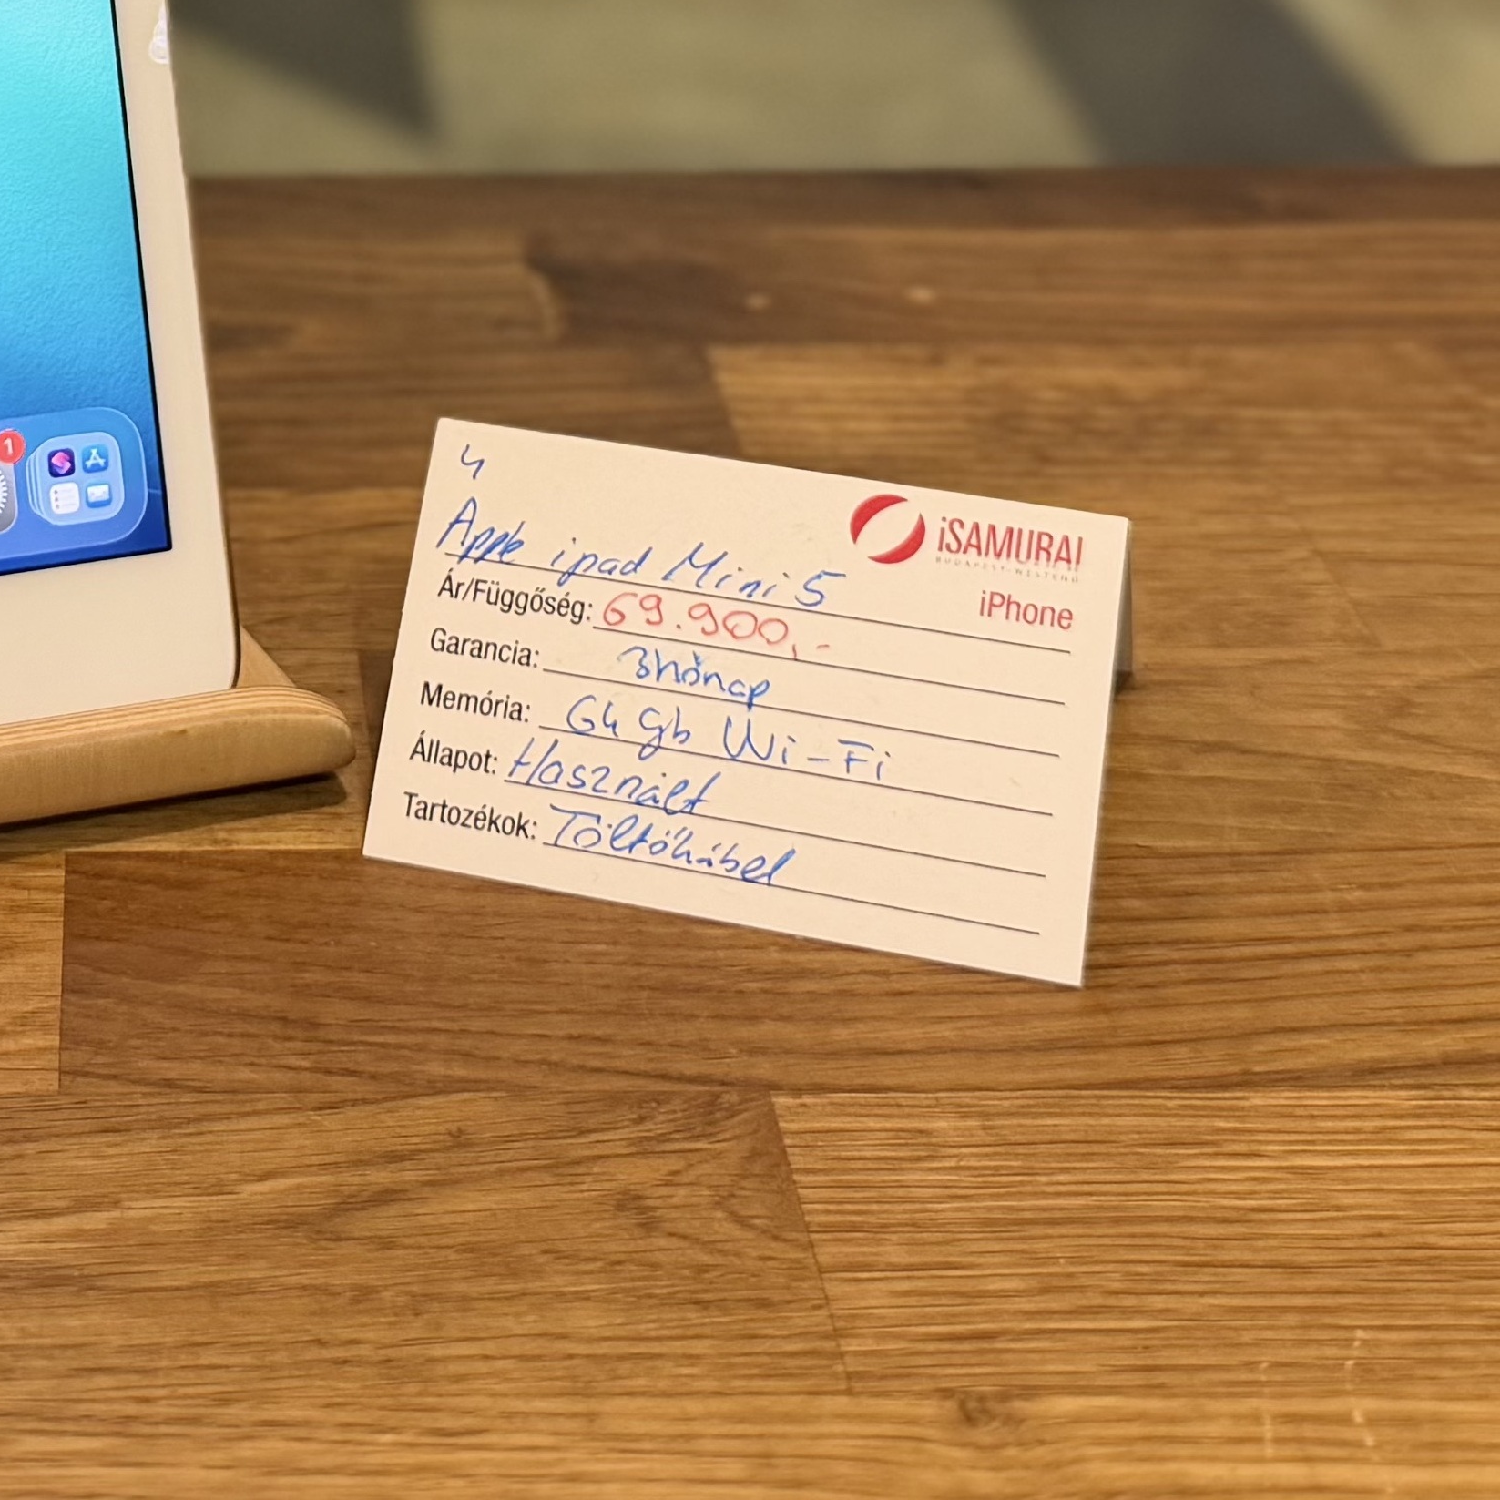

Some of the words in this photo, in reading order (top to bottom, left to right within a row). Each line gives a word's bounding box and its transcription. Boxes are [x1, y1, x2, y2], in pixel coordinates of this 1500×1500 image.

[3, 436, 16, 456] 1
[937, 516, 1083, 566] iSAMURAI
[437, 567, 593, 623] Ár/Függőség:
[662, 541, 791, 599] Mini
[795, 570, 846, 607] 5
[979, 589, 1073, 630] iPhone
[430, 627, 540, 669] Garancia:
[420, 681, 531, 723] Memória:
[409, 731, 498, 775] Állapot:
[403, 791, 537, 840] Tartozékok:
